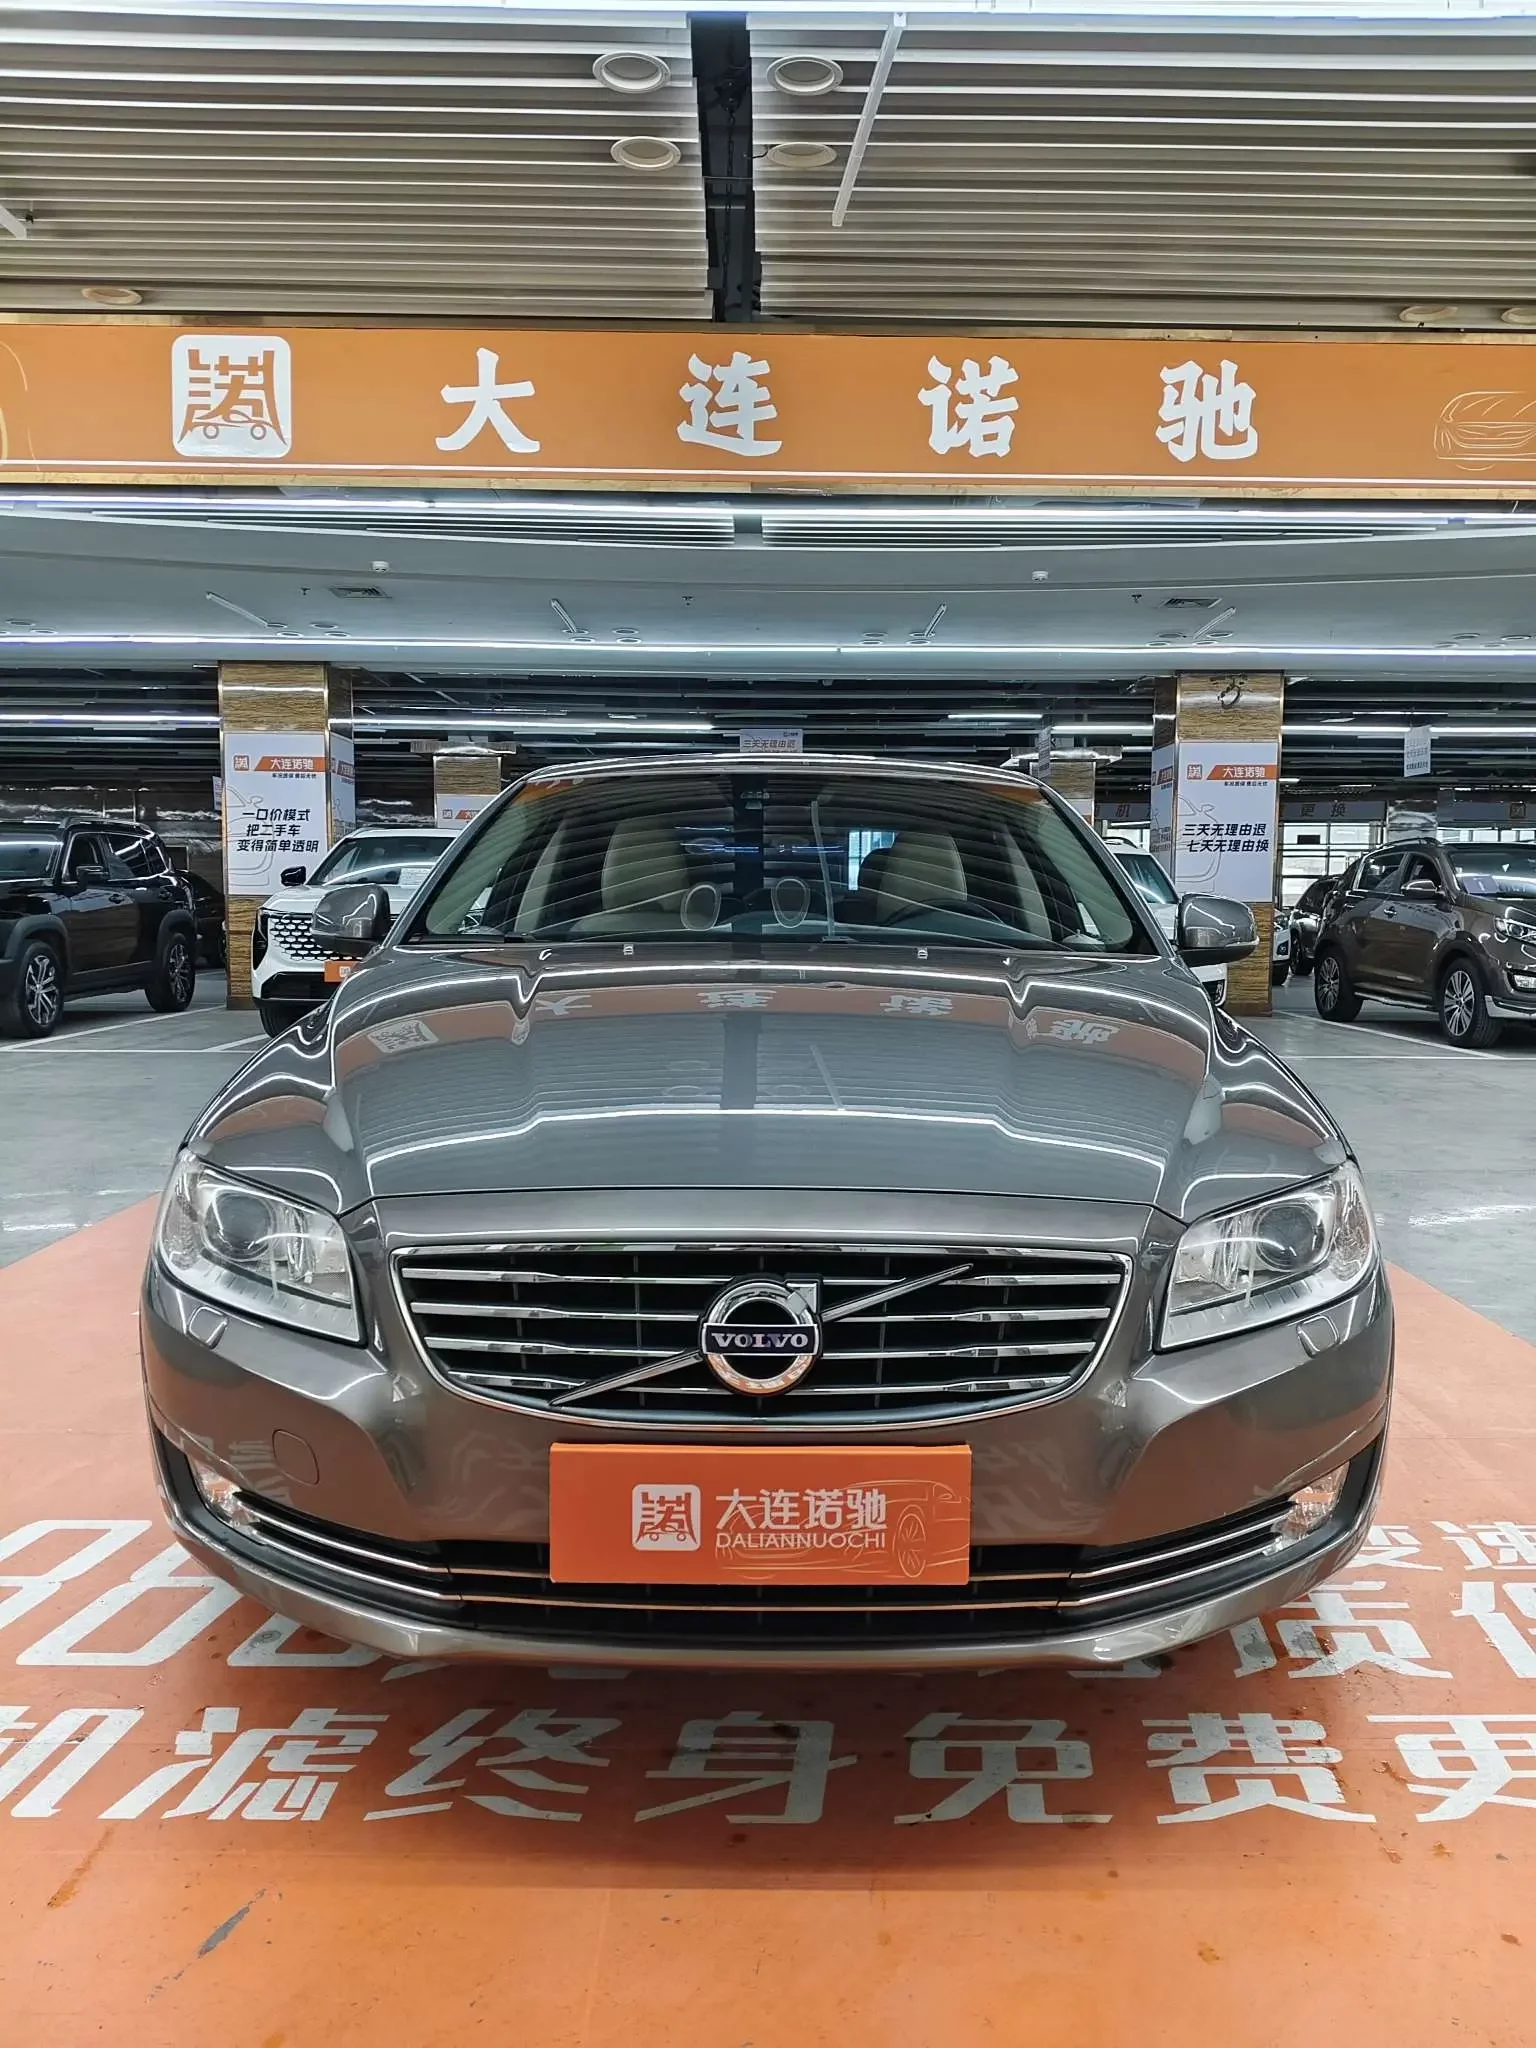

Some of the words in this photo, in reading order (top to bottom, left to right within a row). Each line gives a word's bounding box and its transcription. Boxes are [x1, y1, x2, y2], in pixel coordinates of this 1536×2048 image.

[435, 347, 1259, 463] 大连诺驰
[270, 757, 314, 771] 大连诺驰
[1222, 766, 1266, 778] 大连诺驰
[242, 808, 311, 822] 一口价模式
[246, 824, 301, 837] 把二手车
[1182, 823, 1267, 837] 三天无理由退
[236, 839, 319, 853] 变得简单透明
[1186, 839, 1269, 853] 七天无理由换
[711, 1331, 810, 1349] VOLVO
[715, 1487, 888, 1530] 大连诺驰
[716, 1532, 887, 1549] DALIANNUOCHI
